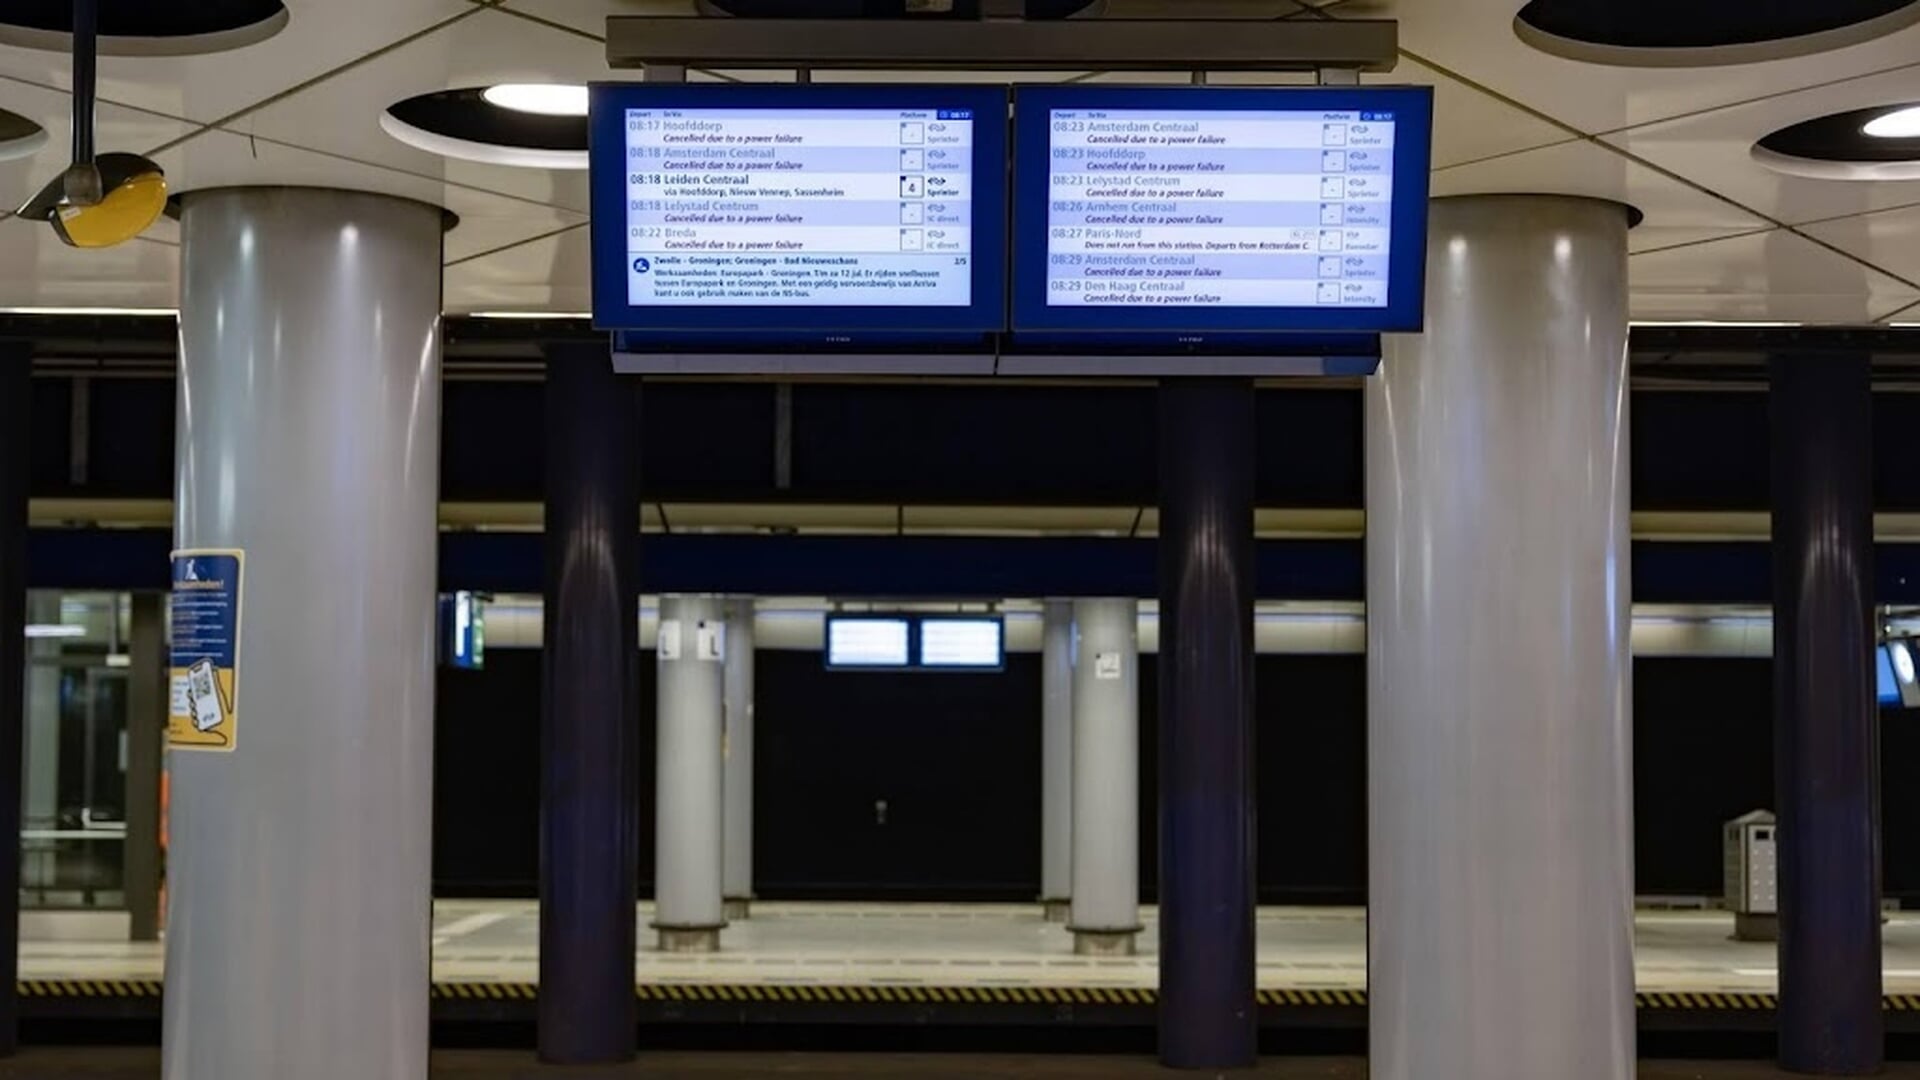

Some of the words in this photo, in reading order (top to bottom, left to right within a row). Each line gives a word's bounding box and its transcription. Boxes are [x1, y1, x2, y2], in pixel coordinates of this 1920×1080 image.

[630, 120, 660, 130] 08:17
[664, 120, 722, 132] Hoofddorp
[1054, 122, 1084, 132] 08:23
[1088, 122, 1150, 132] Amsterdam
[1152, 122, 1199, 132] Centraal
[664, 134, 705, 142] Cancelled
[707, 134, 723, 142] due
[726, 134, 735, 142] to
[745, 136, 772, 144] power
[775, 134, 802, 142] failure
[1087, 135, 1129, 143] Cancelled
[1131, 135, 1147, 143] due
[1150, 135, 1159, 143] to
[1168, 137, 1195, 145] power
[1198, 135, 1225, 143] failure
[630, 148, 660, 158] 08:18
[664, 148, 726, 158] Amsterdam
[729, 148, 776, 158] Centraal
[1053, 149, 1084, 158] 08:23
[1087, 148, 1146, 160] Hoofddorp
[664, 161, 705, 169] Cancelled
[707, 161, 723, 169] due
[726, 161, 735, 169] to
[745, 163, 772, 171] power
[775, 161, 802, 169] failure
[1087, 162, 1128, 170] Cancelled
[1130, 162, 1146, 170] due
[1150, 162, 1157, 170] to
[1167, 164, 1194, 172] power
[1198, 162, 1224, 170] failure
[630, 174, 660, 184] 08:18
[664, 174, 700, 184] Leiden
[702, 174, 749, 184] Centraal
[1053, 176, 1082, 185] 08:23
[1087, 176, 1131, 188] Lelystad
[1134, 176, 1180, 186] Centrum
[664, 188, 677, 196] via
[680, 188, 727, 198] Hoofddorp,
[729, 188, 756, 196] Nieuw
[758, 188, 792, 198] Vennep,
[794, 188, 844, 196] Sassenheim
[908, 184, 915, 192] 4
[927, 189, 959, 197] Sprinter
[1086, 189, 1127, 197] Cancelled
[1130, 189, 1145, 197] due
[1148, 189, 1157, 197] to
[1167, 191, 1194, 199] power
[1196, 189, 1224, 197] failure
[631, 202, 660, 211] 08:18
[665, 201, 709, 213] Lelystad
[712, 201, 758, 211] Centrum
[1053, 202, 1083, 211] 08:26
[1086, 202, 1128, 212] Arnhem
[1131, 202, 1176, 212] Centraal
[664, 214, 706, 222] Cancelled
[709, 214, 724, 222] due
[727, 214, 736, 222] to
[745, 216, 772, 224] power
[776, 214, 802, 222] failure
[1085, 215, 1126, 224] Cancelled
[1129, 215, 1144, 224] due
[1148, 215, 1156, 224] to
[1196, 215, 1223, 224] failure
[632, 228, 660, 238] 08:22
[665, 228, 696, 238] Breda
[1052, 228, 1082, 238] 08:27
[1085, 229, 1142, 238] Paris-Nord
[664, 240, 706, 249] Cancelled
[709, 240, 724, 249] due
[727, 240, 736, 249] to
[745, 243, 772, 251] power
[776, 240, 802, 249] failure
[1084, 241, 1104, 249] Does
[1138, 241, 1156, 249] from
[1158, 241, 1172, 249] this
[1206, 242, 1236, 250] Departs
[1238, 242, 1257, 250] from
[1260, 242, 1300, 250] Rotterdam
[734, 257, 776, 266] Groningen
[1052, 255, 1082, 264] 08:29
[1085, 254, 1146, 265] Amsterdam
[1150, 255, 1195, 265] Centraal
[721, 270, 764, 278] Europapark
[874, 270, 896, 278] rijden
[1085, 268, 1125, 276] Cancelled
[1128, 268, 1143, 276] due
[1147, 268, 1155, 276] to
[1164, 270, 1191, 278] power
[1194, 268, 1221, 276] failure
[682, 280, 724, 288] Europapark
[814, 280, 838, 288] geldig
[840, 280, 896, 288] vervoersbewijs
[1052, 281, 1081, 291] 08:29
[1084, 281, 1105, 291] Den
[1109, 281, 1137, 292] Haag
[1140, 281, 1185, 291] Centraal
[697, 290, 726, 298] gebruik
[1084, 294, 1125, 303] Cancelled
[1128, 294, 1143, 303] due
[1146, 294, 1155, 303] to
[1164, 296, 1191, 304] power
[1194, 294, 1220, 303] failure
